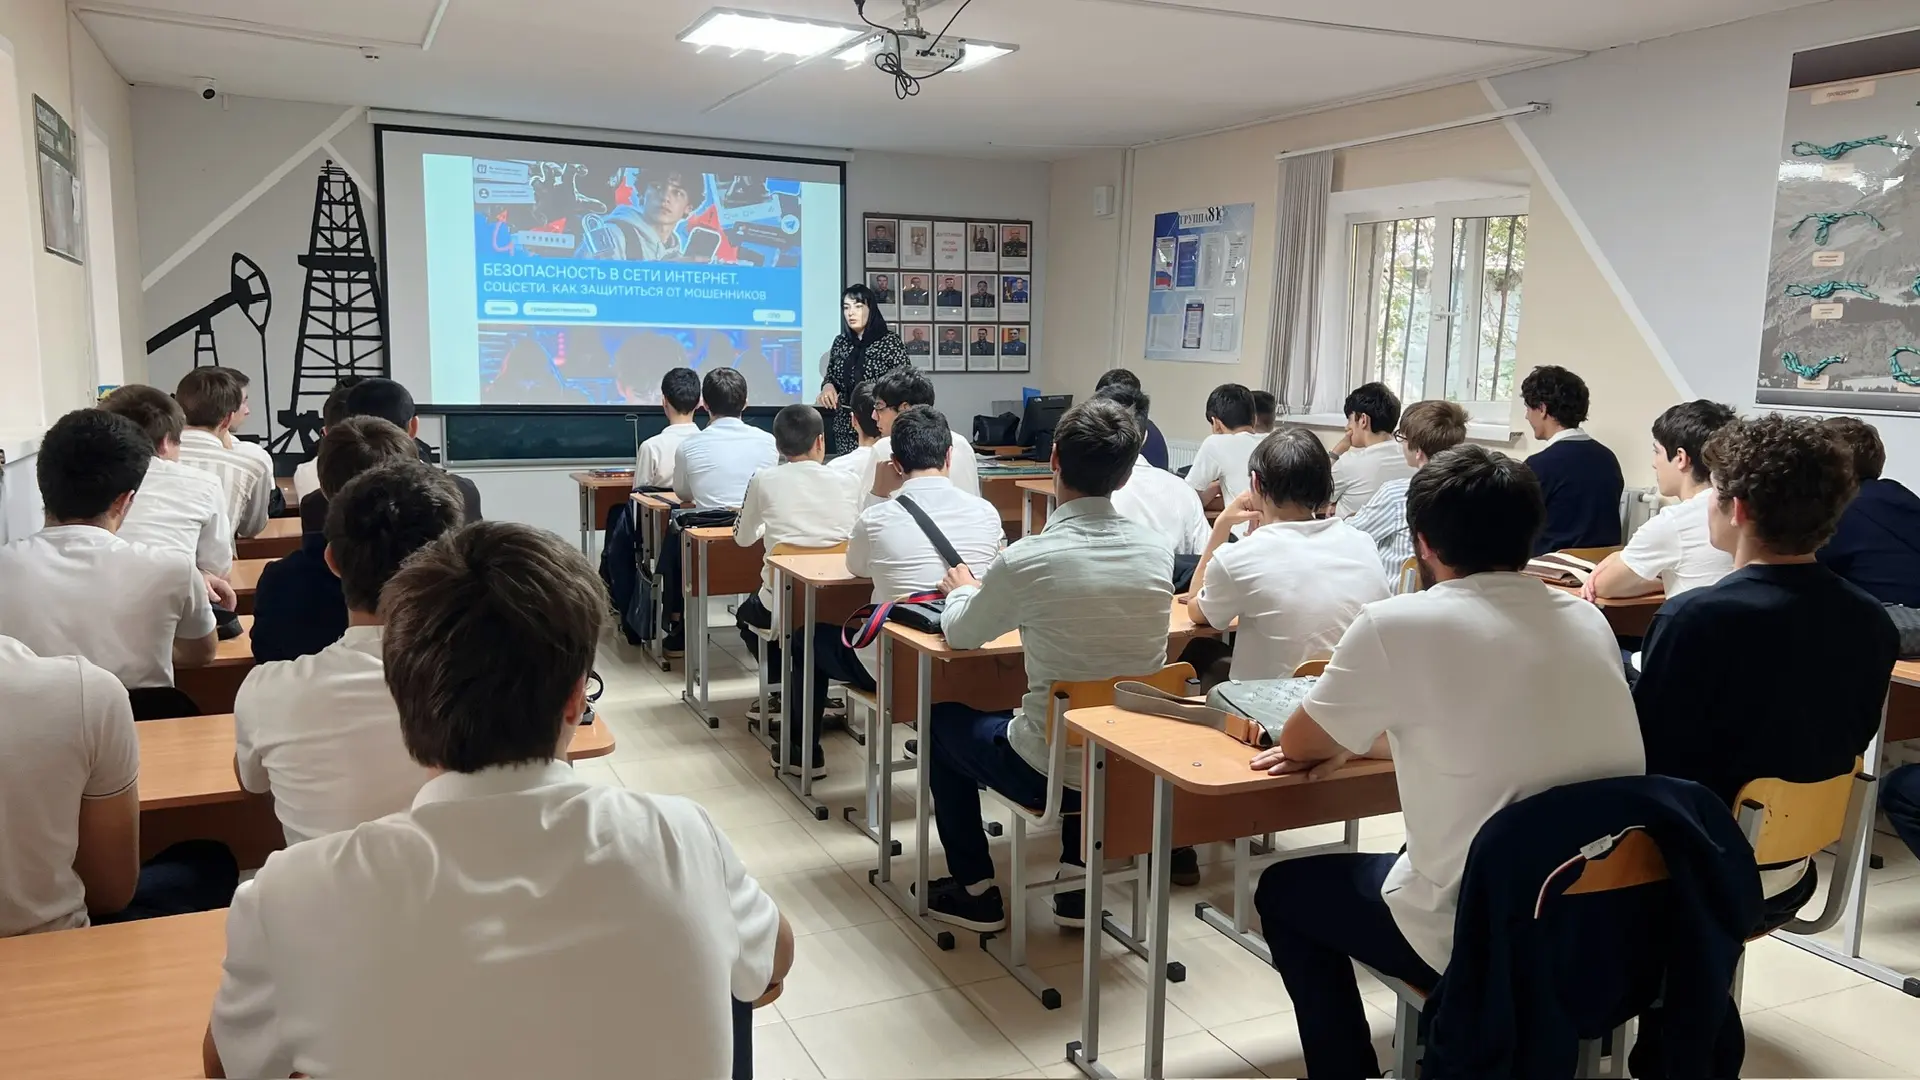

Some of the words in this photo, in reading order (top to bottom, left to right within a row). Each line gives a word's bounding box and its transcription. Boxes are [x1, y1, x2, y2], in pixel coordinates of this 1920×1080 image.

[1180, 213, 1208, 225] ГРУППА
[483, 263, 606, 280] БЕЗОПАСНОСТЬ
[610, 268, 619, 280] В
[623, 269, 661, 282] СЕТИ
[664, 271, 739, 285] ИНТЕРНЕТ.
[483, 281, 549, 293] СОЦСЕТИ.
[552, 283, 577, 294] КАК
[580, 284, 663, 297] ЗАЩИТИТЬСЯ
[666, 286, 681, 297] ОТ
[684, 288, 766, 300] МОШЕННИКОВ
